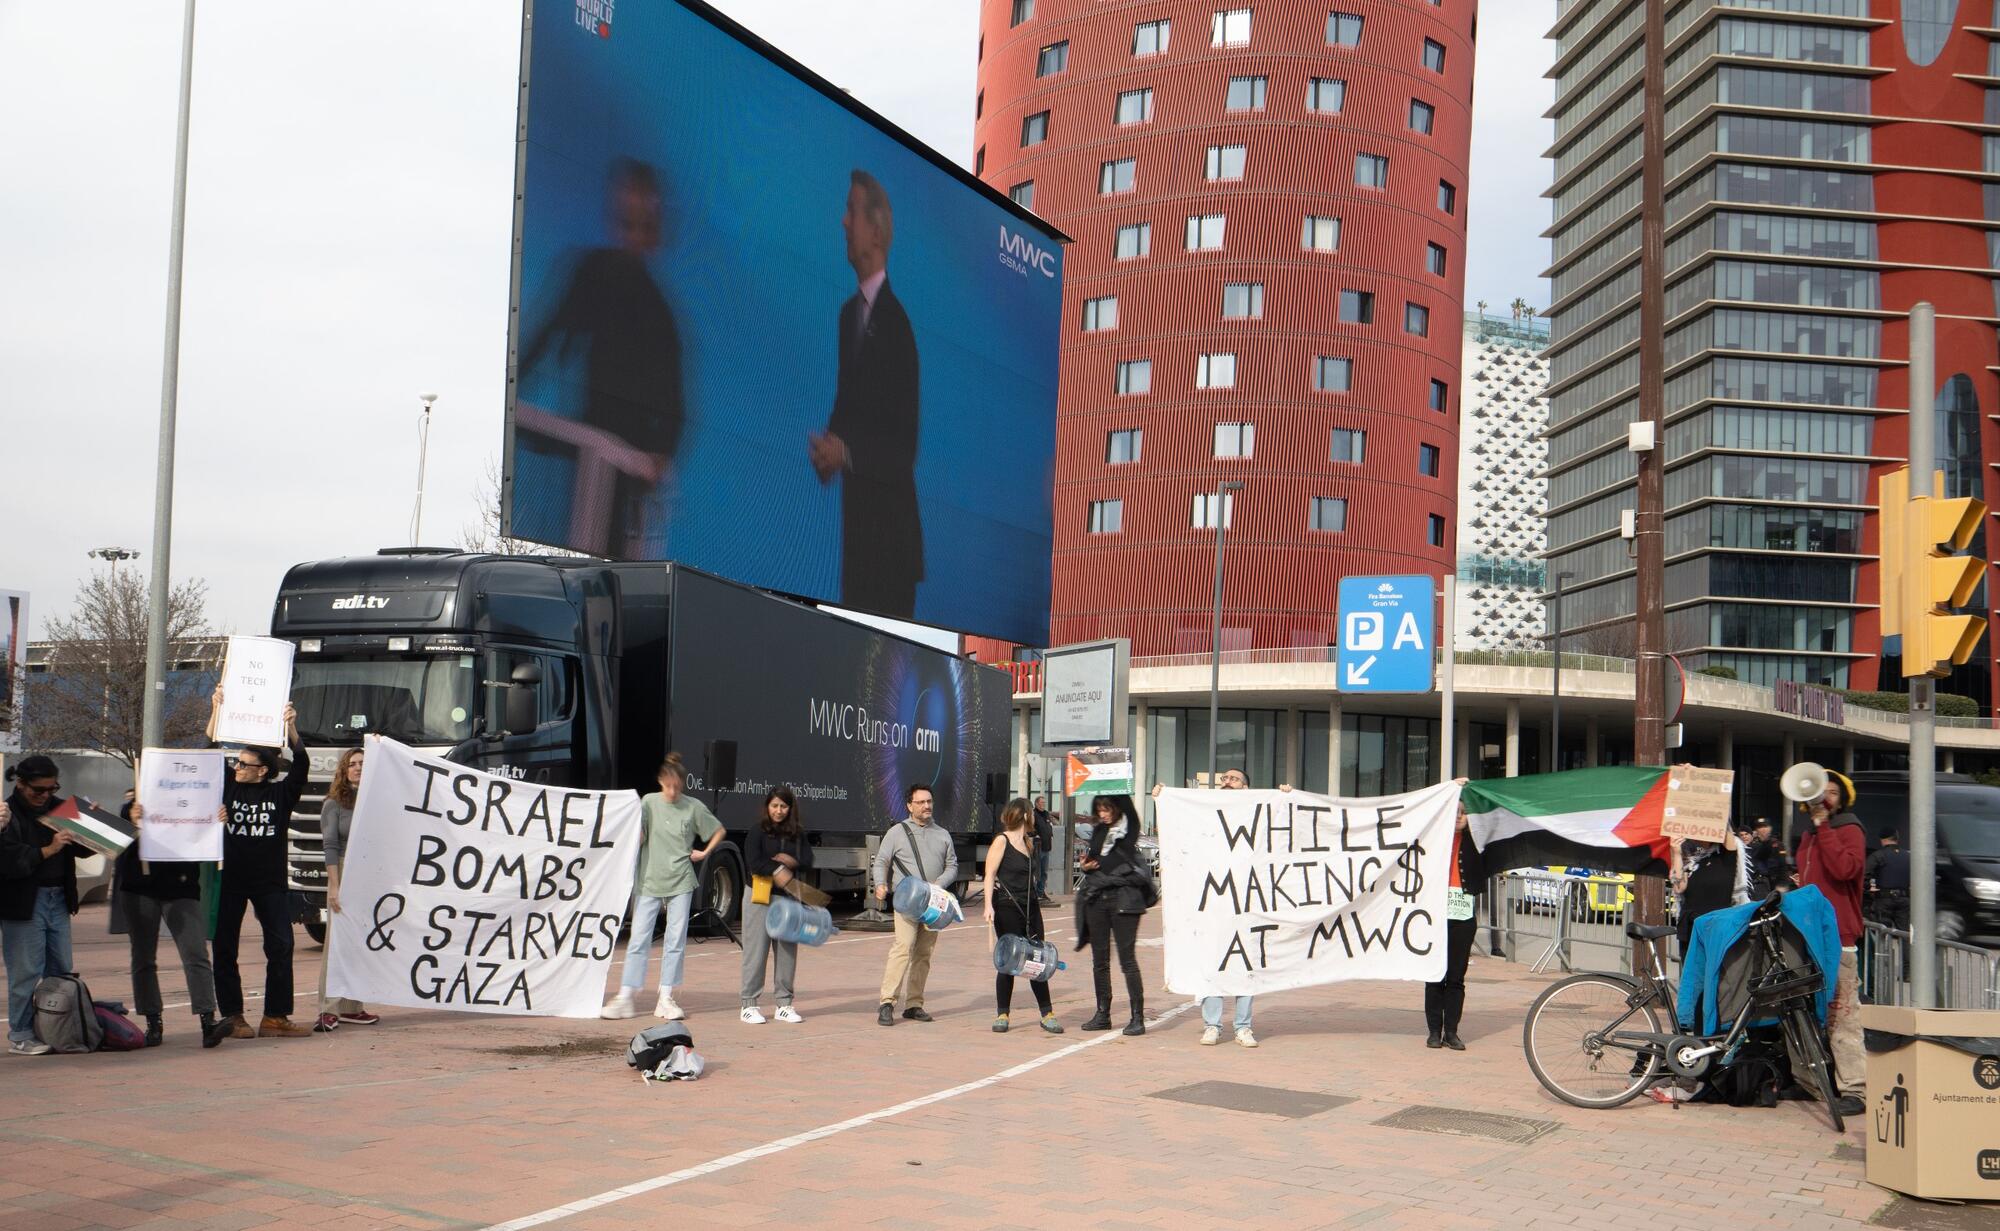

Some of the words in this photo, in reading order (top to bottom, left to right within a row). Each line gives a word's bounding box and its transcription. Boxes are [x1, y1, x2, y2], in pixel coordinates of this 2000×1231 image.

[575, 7, 599, 35] LIVE
[1000, 225, 1055, 278] MWC
[999, 252, 1028, 278] GSMA
[332, 594, 390, 609] adi.tv
[1353, 617, 1376, 646] P
[1391, 612, 1424, 650] A
[249, 661, 264, 670] NO
[240, 676, 267, 687] TECH
[248, 695, 256, 703] 4
[810, 697, 854, 740] MWC
[857, 707, 889, 745] Runs
[891, 723, 908, 749] on
[915, 727, 940, 753] arm
[173, 762, 198, 774] The
[487, 764, 527, 779] adi.tv
[686, 773, 705, 791] Ove
[803, 782, 827, 801] Shipped
[827, 786, 834, 799] to
[834, 785, 848, 800] Date
[177, 797, 189, 808] is
[232, 800, 258, 813] NOT
[262, 801, 276, 811] IN
[404, 760, 614, 848] ISRAEL
[234, 812, 271, 823] OUR
[1217, 803, 1408, 853] WHILE
[1663, 821, 1725, 839] GENOCIDE
[411, 835, 586, 901] BOMBS
[1198, 857, 1383, 915] MAKING
[1390, 839, 1426, 903] $
[1454, 892, 1465, 900] THE
[366, 893, 406, 952] &
[422, 904, 620, 961] STARVES
[1218, 924, 1279, 971] AT
[1307, 908, 1433, 959] MWC
[410, 954, 532, 1010] GAZA
[1933, 1093, 1984, 1104] Ajuntament
[1986, 1095, 1997, 1103] de
